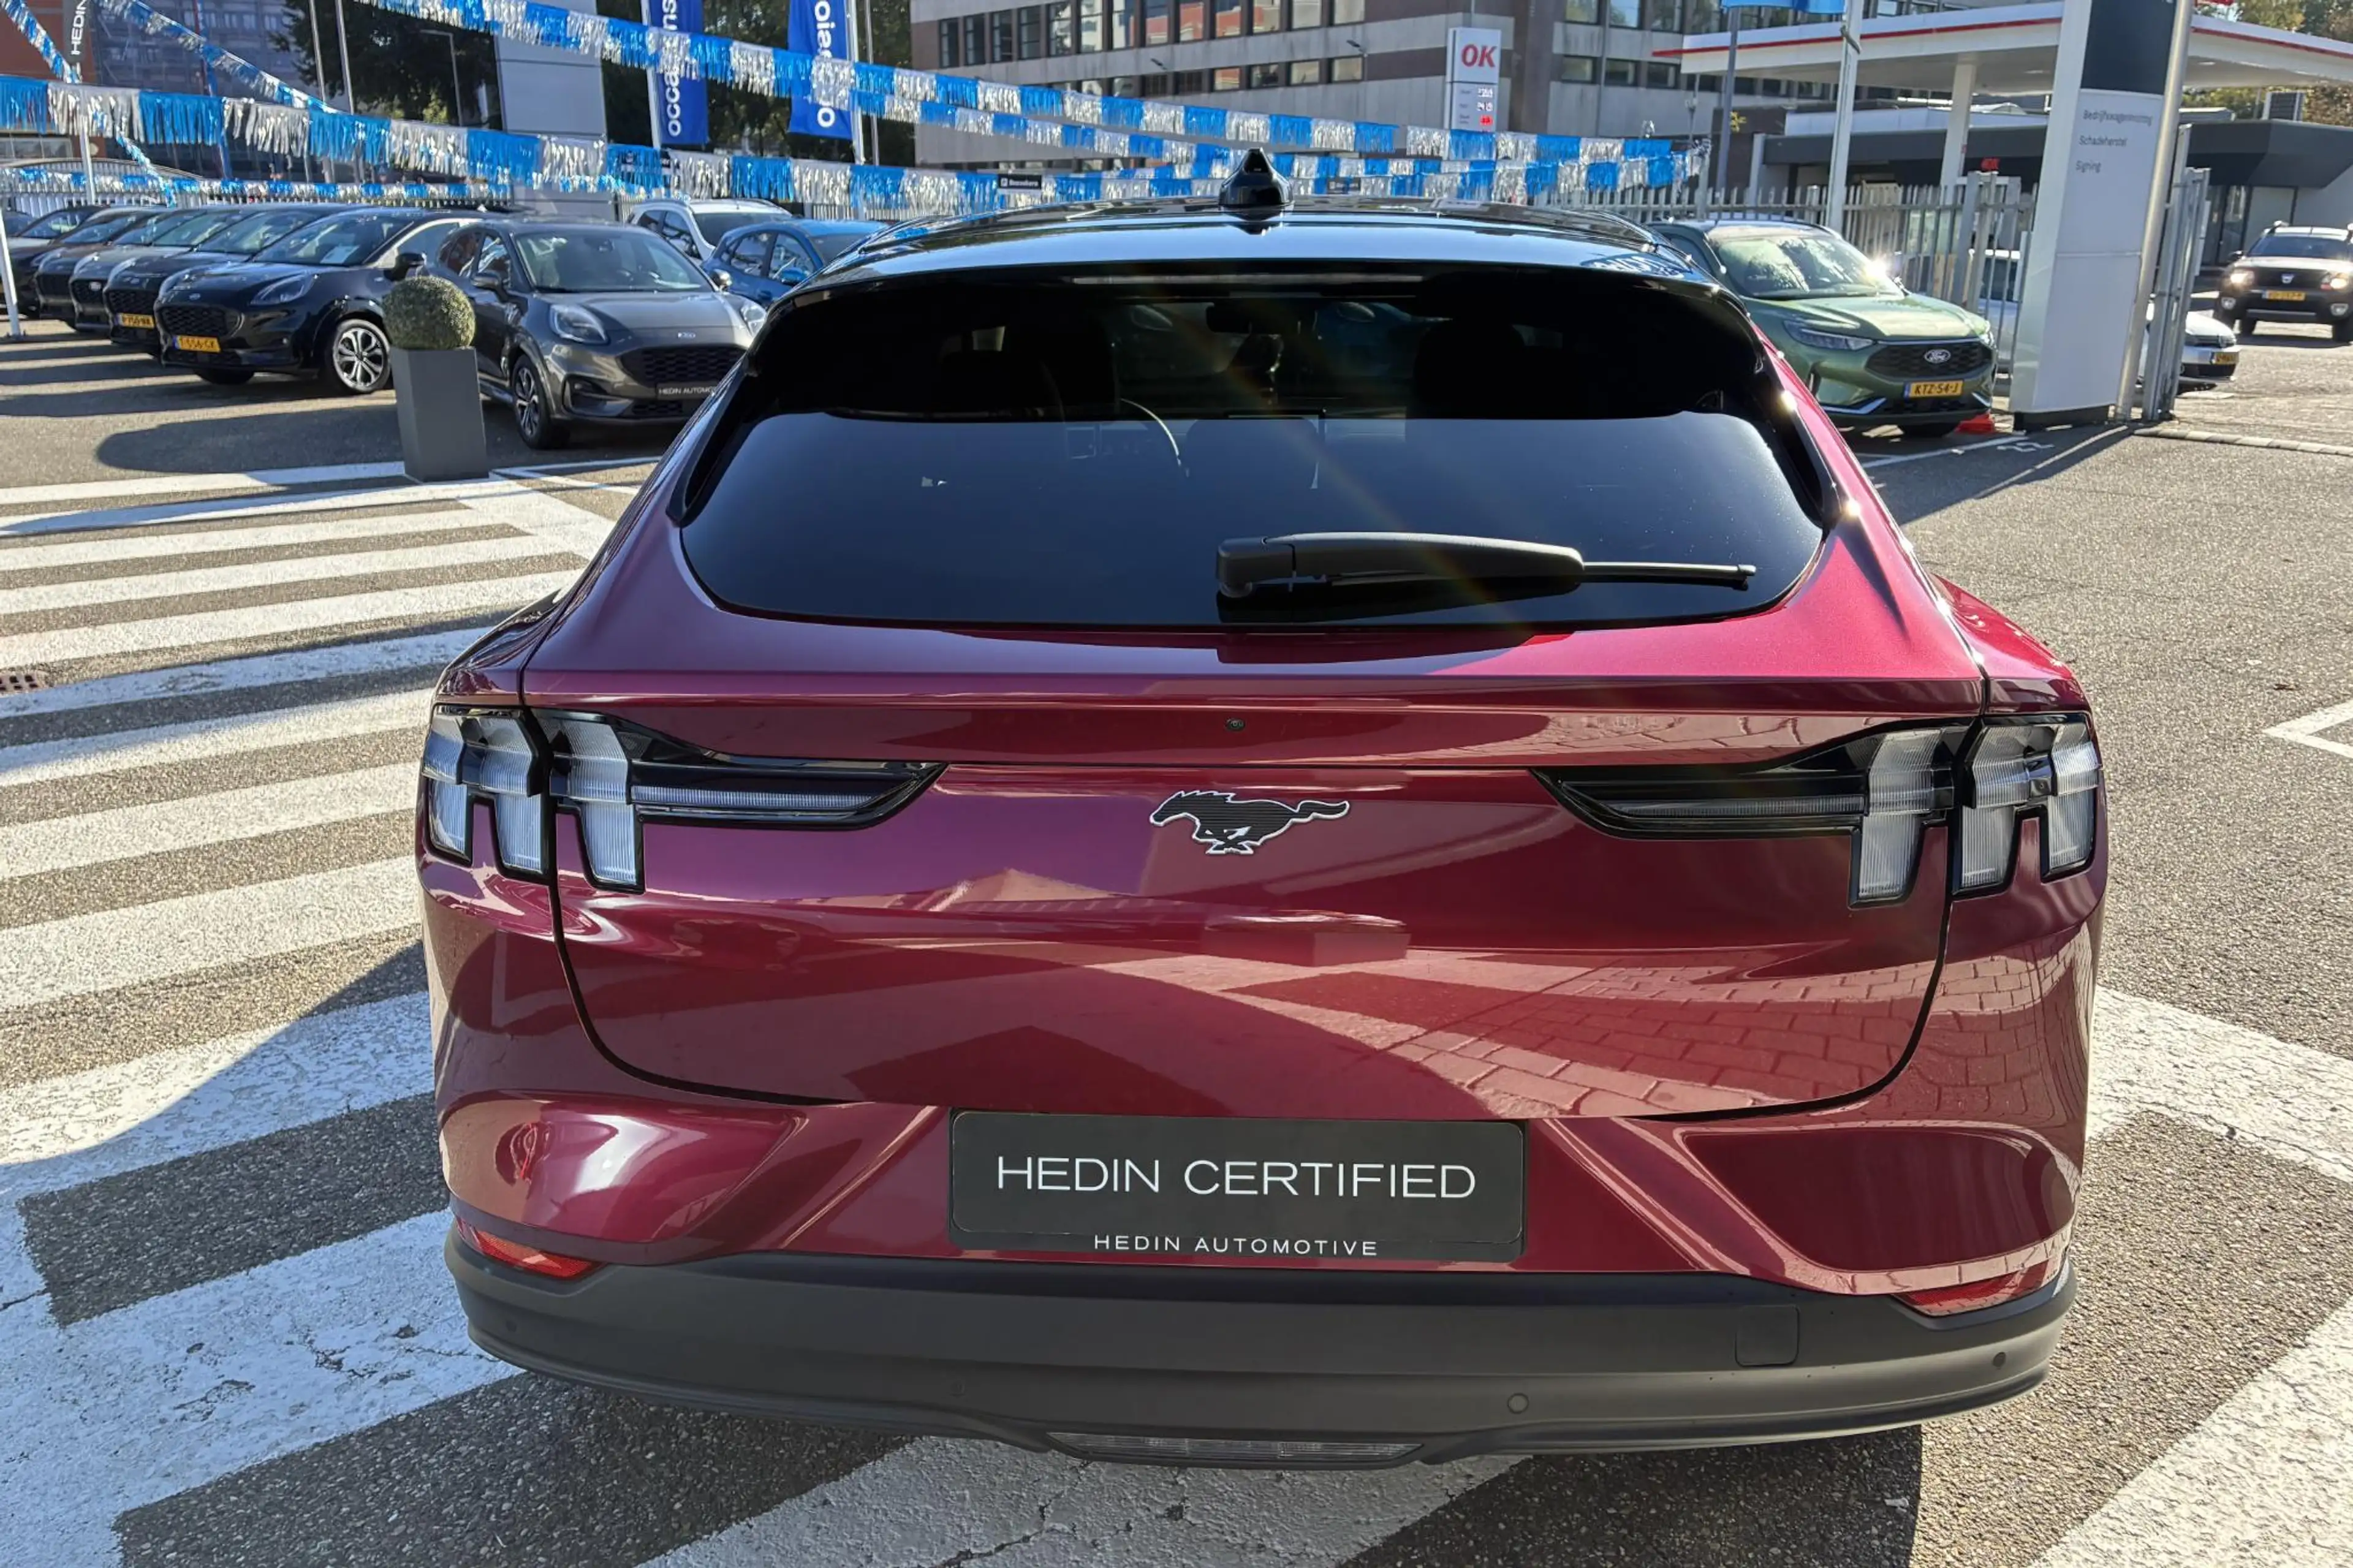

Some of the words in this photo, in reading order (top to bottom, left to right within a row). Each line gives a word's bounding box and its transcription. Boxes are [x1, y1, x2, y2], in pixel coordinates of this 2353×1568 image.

[1461, 44, 1498, 67] OK
[998, 1156, 1159, 1193] HEDIN
[1184, 1160, 1476, 1198] CERTIFIED
[1094, 1234, 1180, 1251] HEDIN
[1194, 1237, 1377, 1256] AUTOMOTIVE
